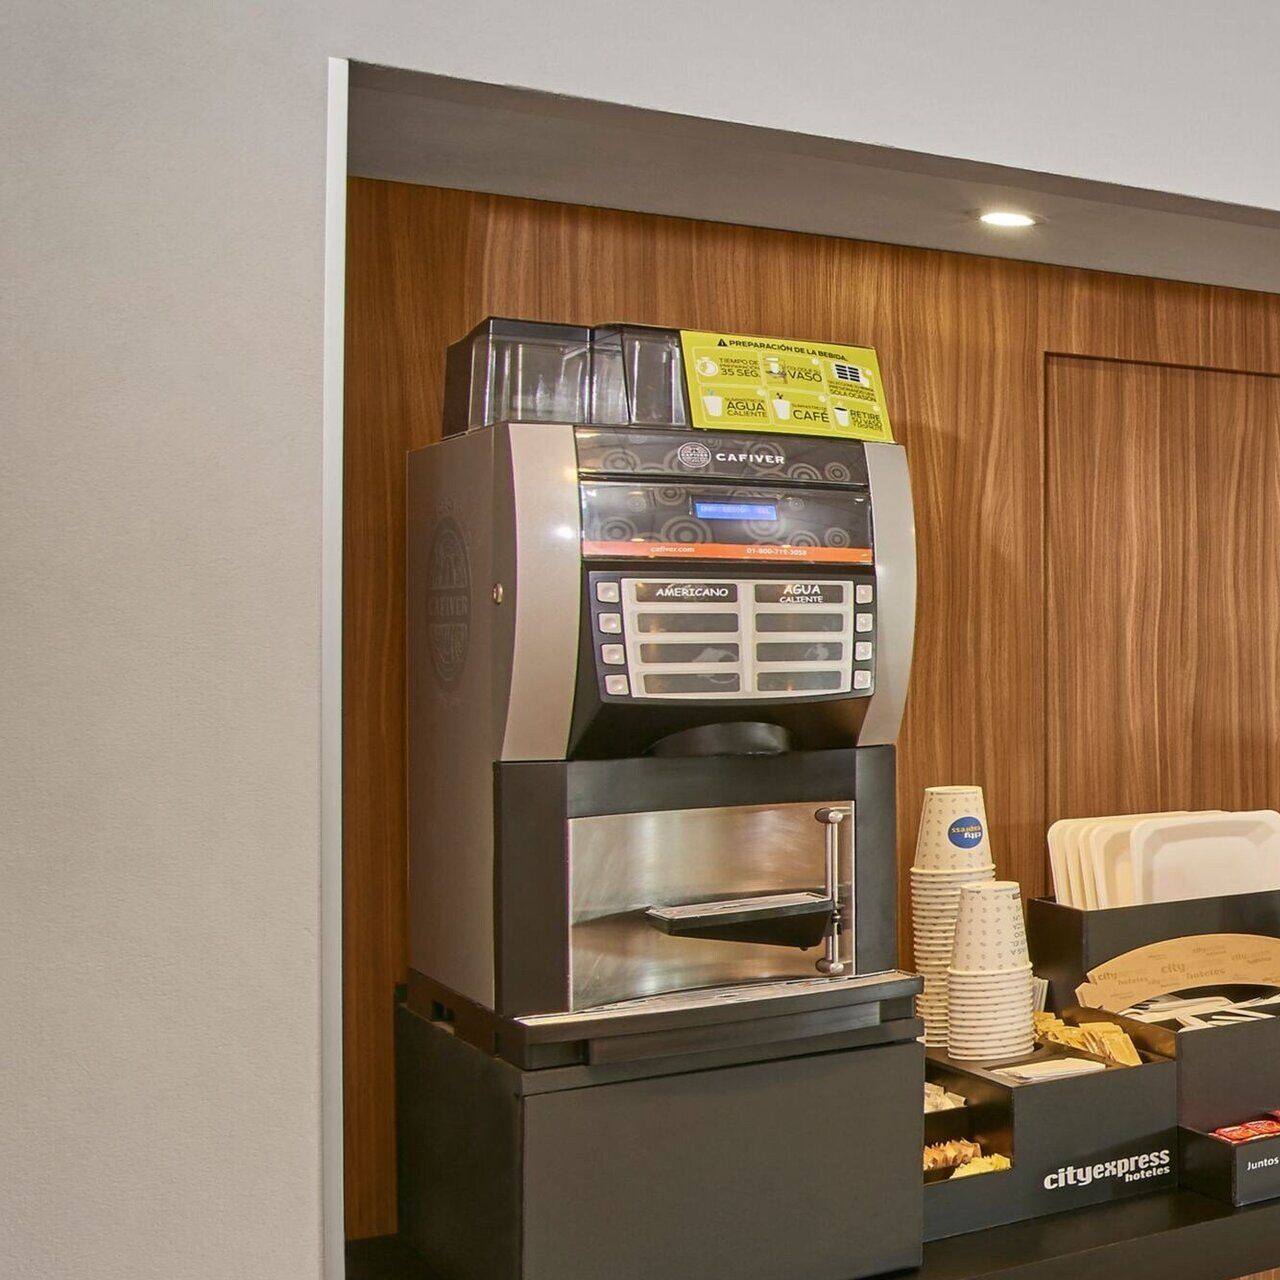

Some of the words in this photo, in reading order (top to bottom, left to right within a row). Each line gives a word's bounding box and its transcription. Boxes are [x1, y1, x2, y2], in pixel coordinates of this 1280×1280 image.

[729, 340, 793, 352] PREPARACIÓN
[720, 357, 748, 365] TIEMPO
[721, 368, 735, 376] 35
[788, 370, 823, 383] VASO
[727, 401, 765, 411] AGUA
[727, 410, 767, 418] CALIENTE
[793, 409, 830, 423] CAFÉ
[850, 409, 880, 420] RETIRE
[716, 453, 785, 464] CAFIVER
[656, 587, 729, 597] AMERICANO
[783, 584, 821, 595] AGUA
[779, 596, 823, 604] CALIENTE
[1161, 961, 1186, 974] city
[1098, 970, 1118, 981] city
[1043, 1149, 1170, 1190] cityexpress
[1247, 1158, 1279, 1171] Juntos
[1125, 1165, 1171, 1182] hoteles
